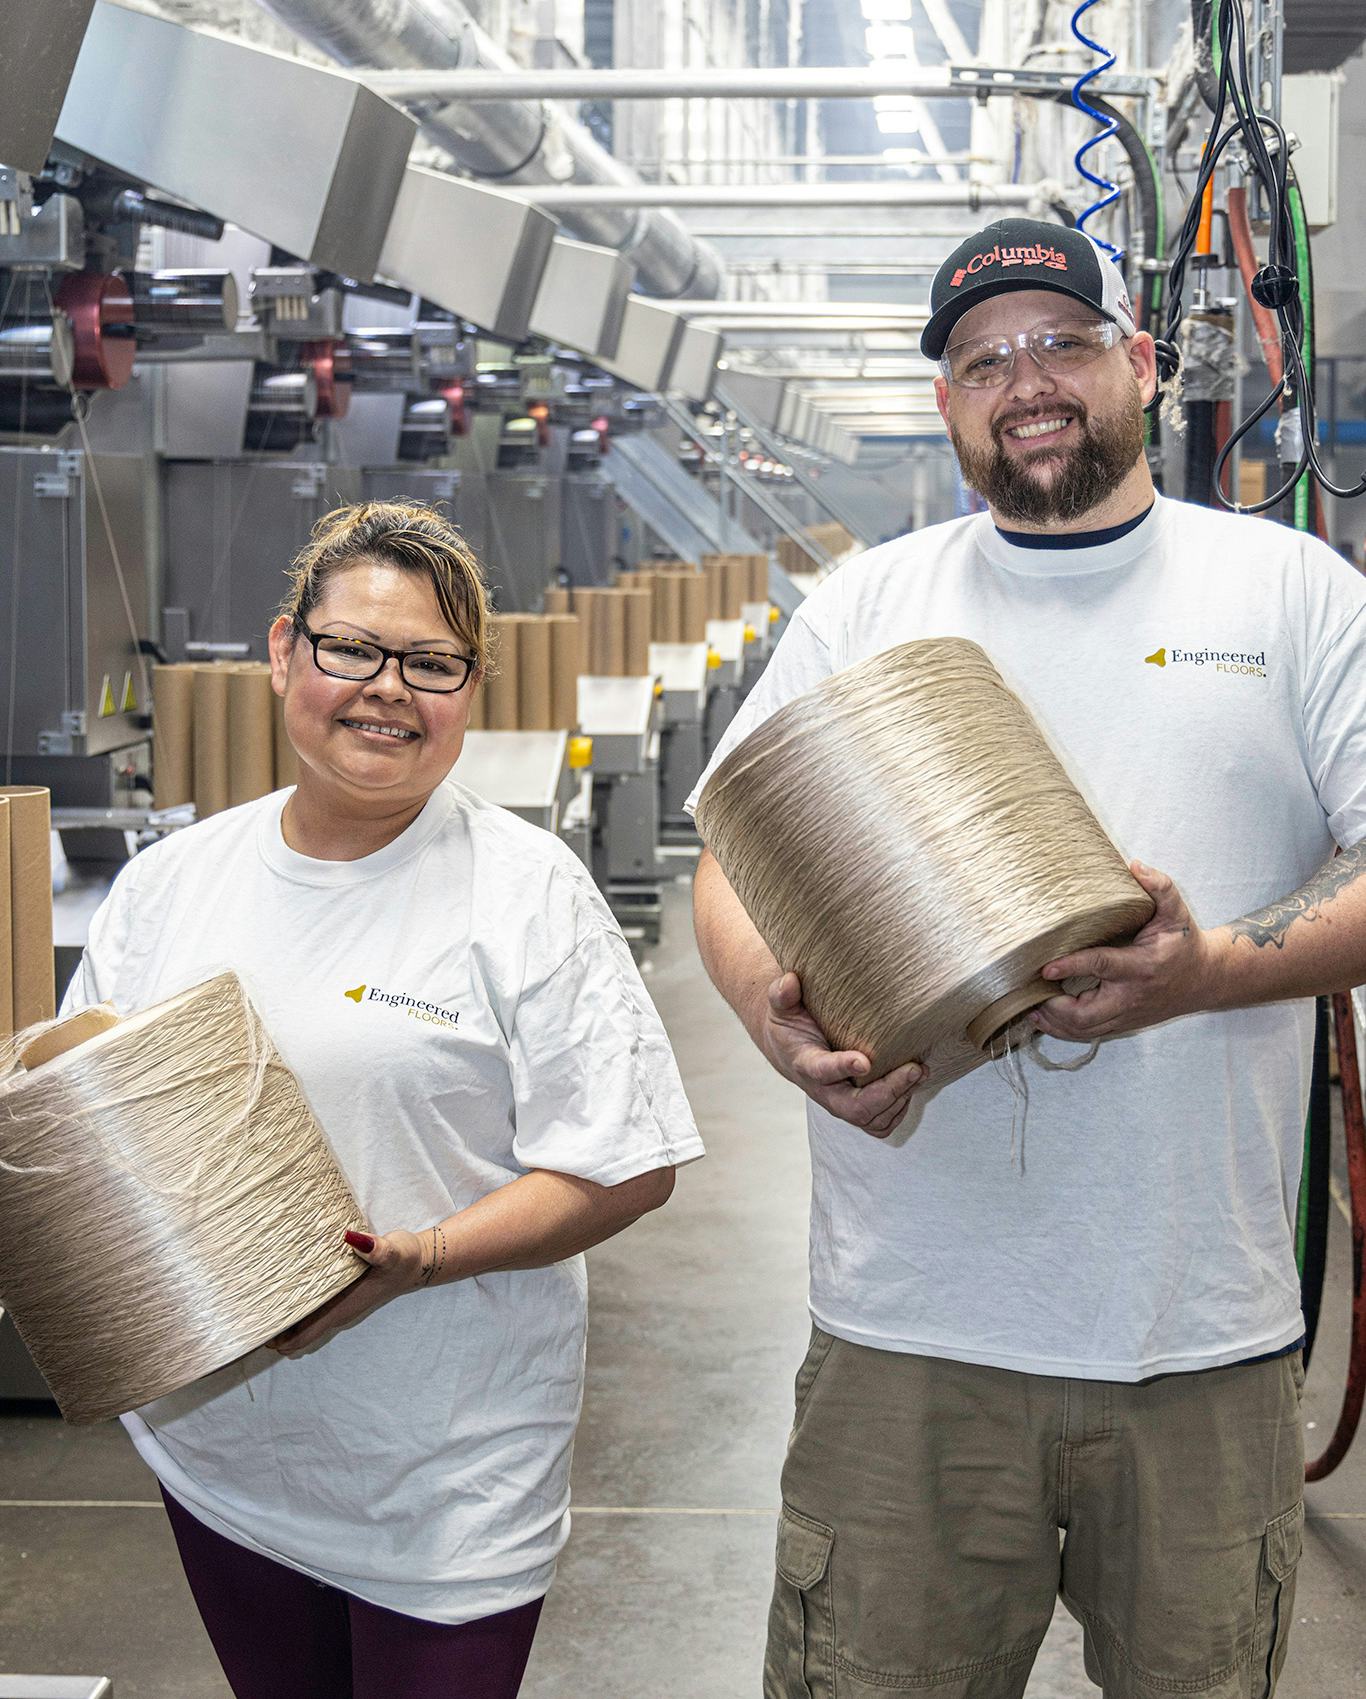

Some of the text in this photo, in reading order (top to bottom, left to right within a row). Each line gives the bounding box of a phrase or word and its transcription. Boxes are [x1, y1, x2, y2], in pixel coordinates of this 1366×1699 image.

[966, 244, 1068, 274] Columbia
[1171, 647, 1266, 666] Engineered
[367, 987, 460, 1024] Engineered
